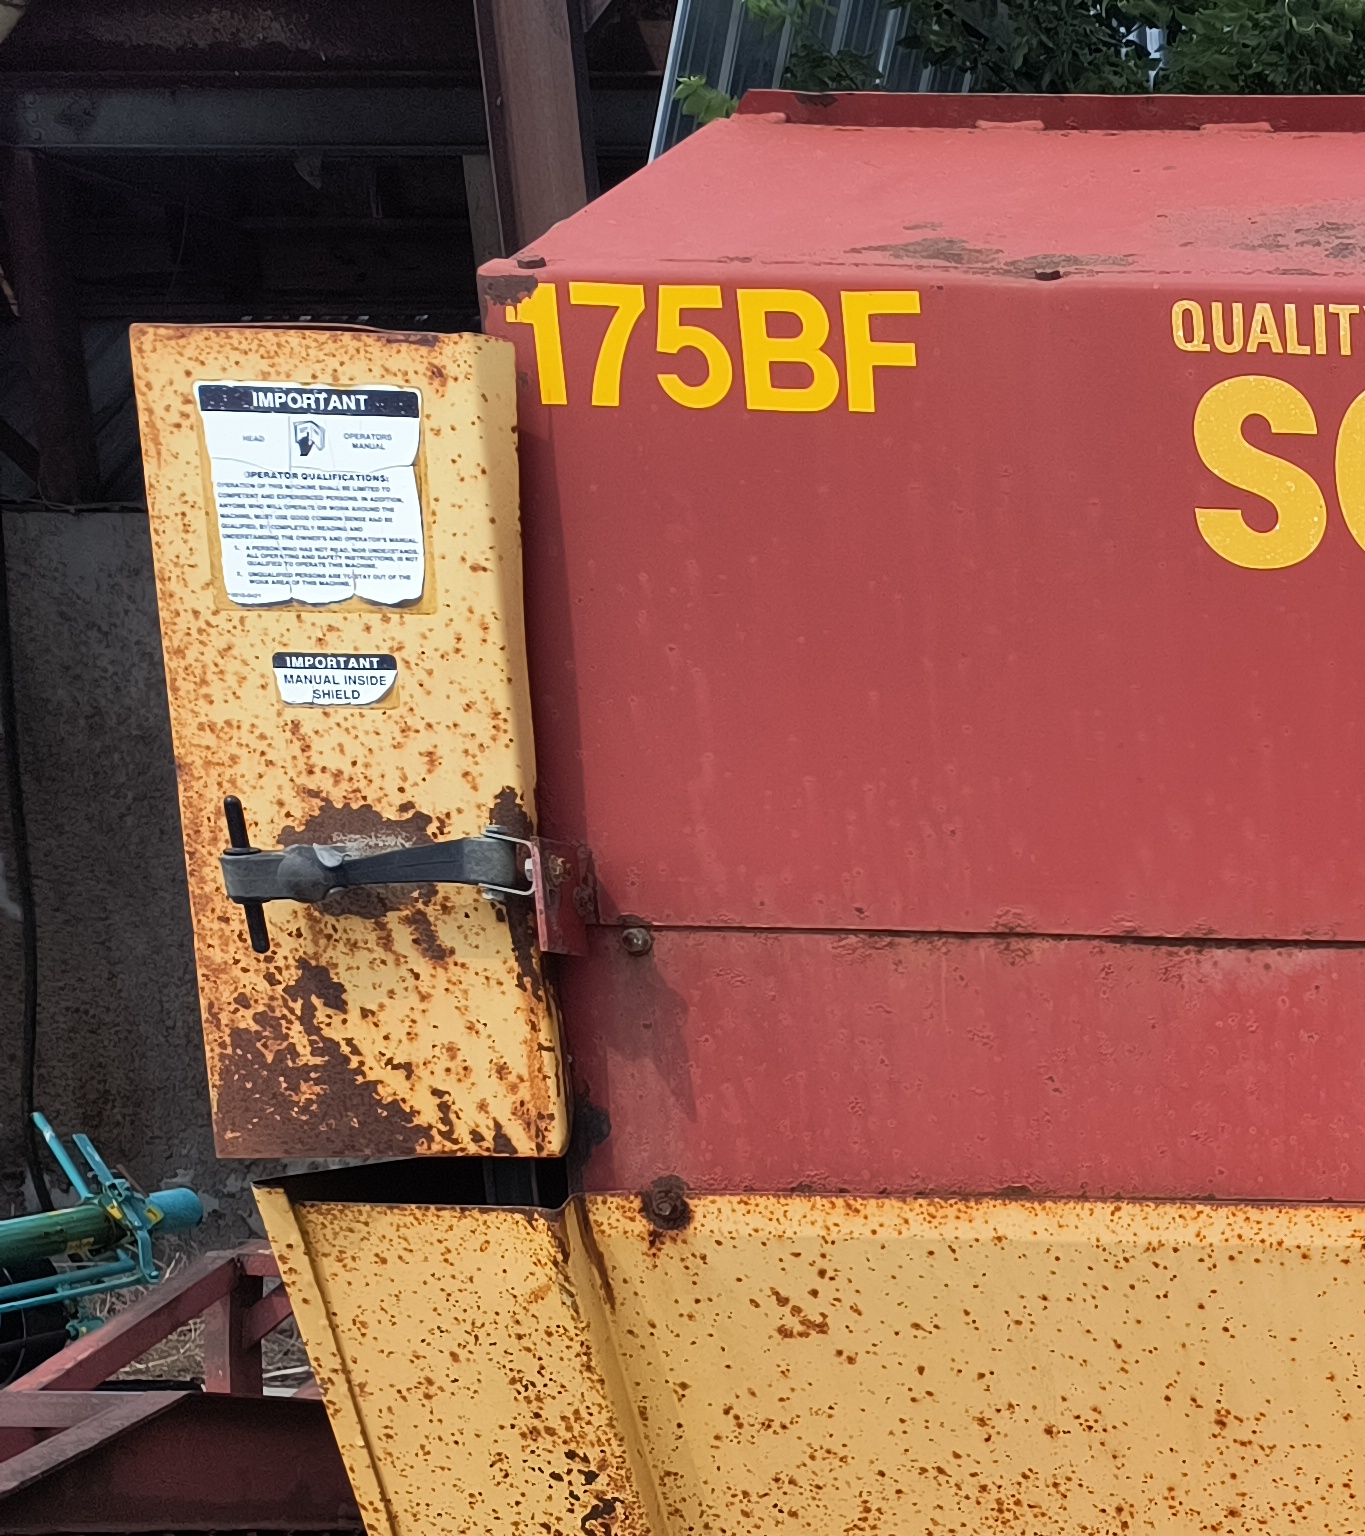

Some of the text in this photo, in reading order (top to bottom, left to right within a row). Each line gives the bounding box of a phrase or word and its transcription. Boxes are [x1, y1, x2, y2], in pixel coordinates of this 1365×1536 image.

[506, 281, 921, 413] 175BF
[251, 390, 369, 411] IMPORTANT
[351, 442, 386, 451] MANUAL
[244, 471, 298, 480] OPERATOR
[284, 656, 380, 669] IMPORTANT
[284, 674, 387, 686] MANUAL INSIDE
[313, 688, 360, 700] SHIELD
